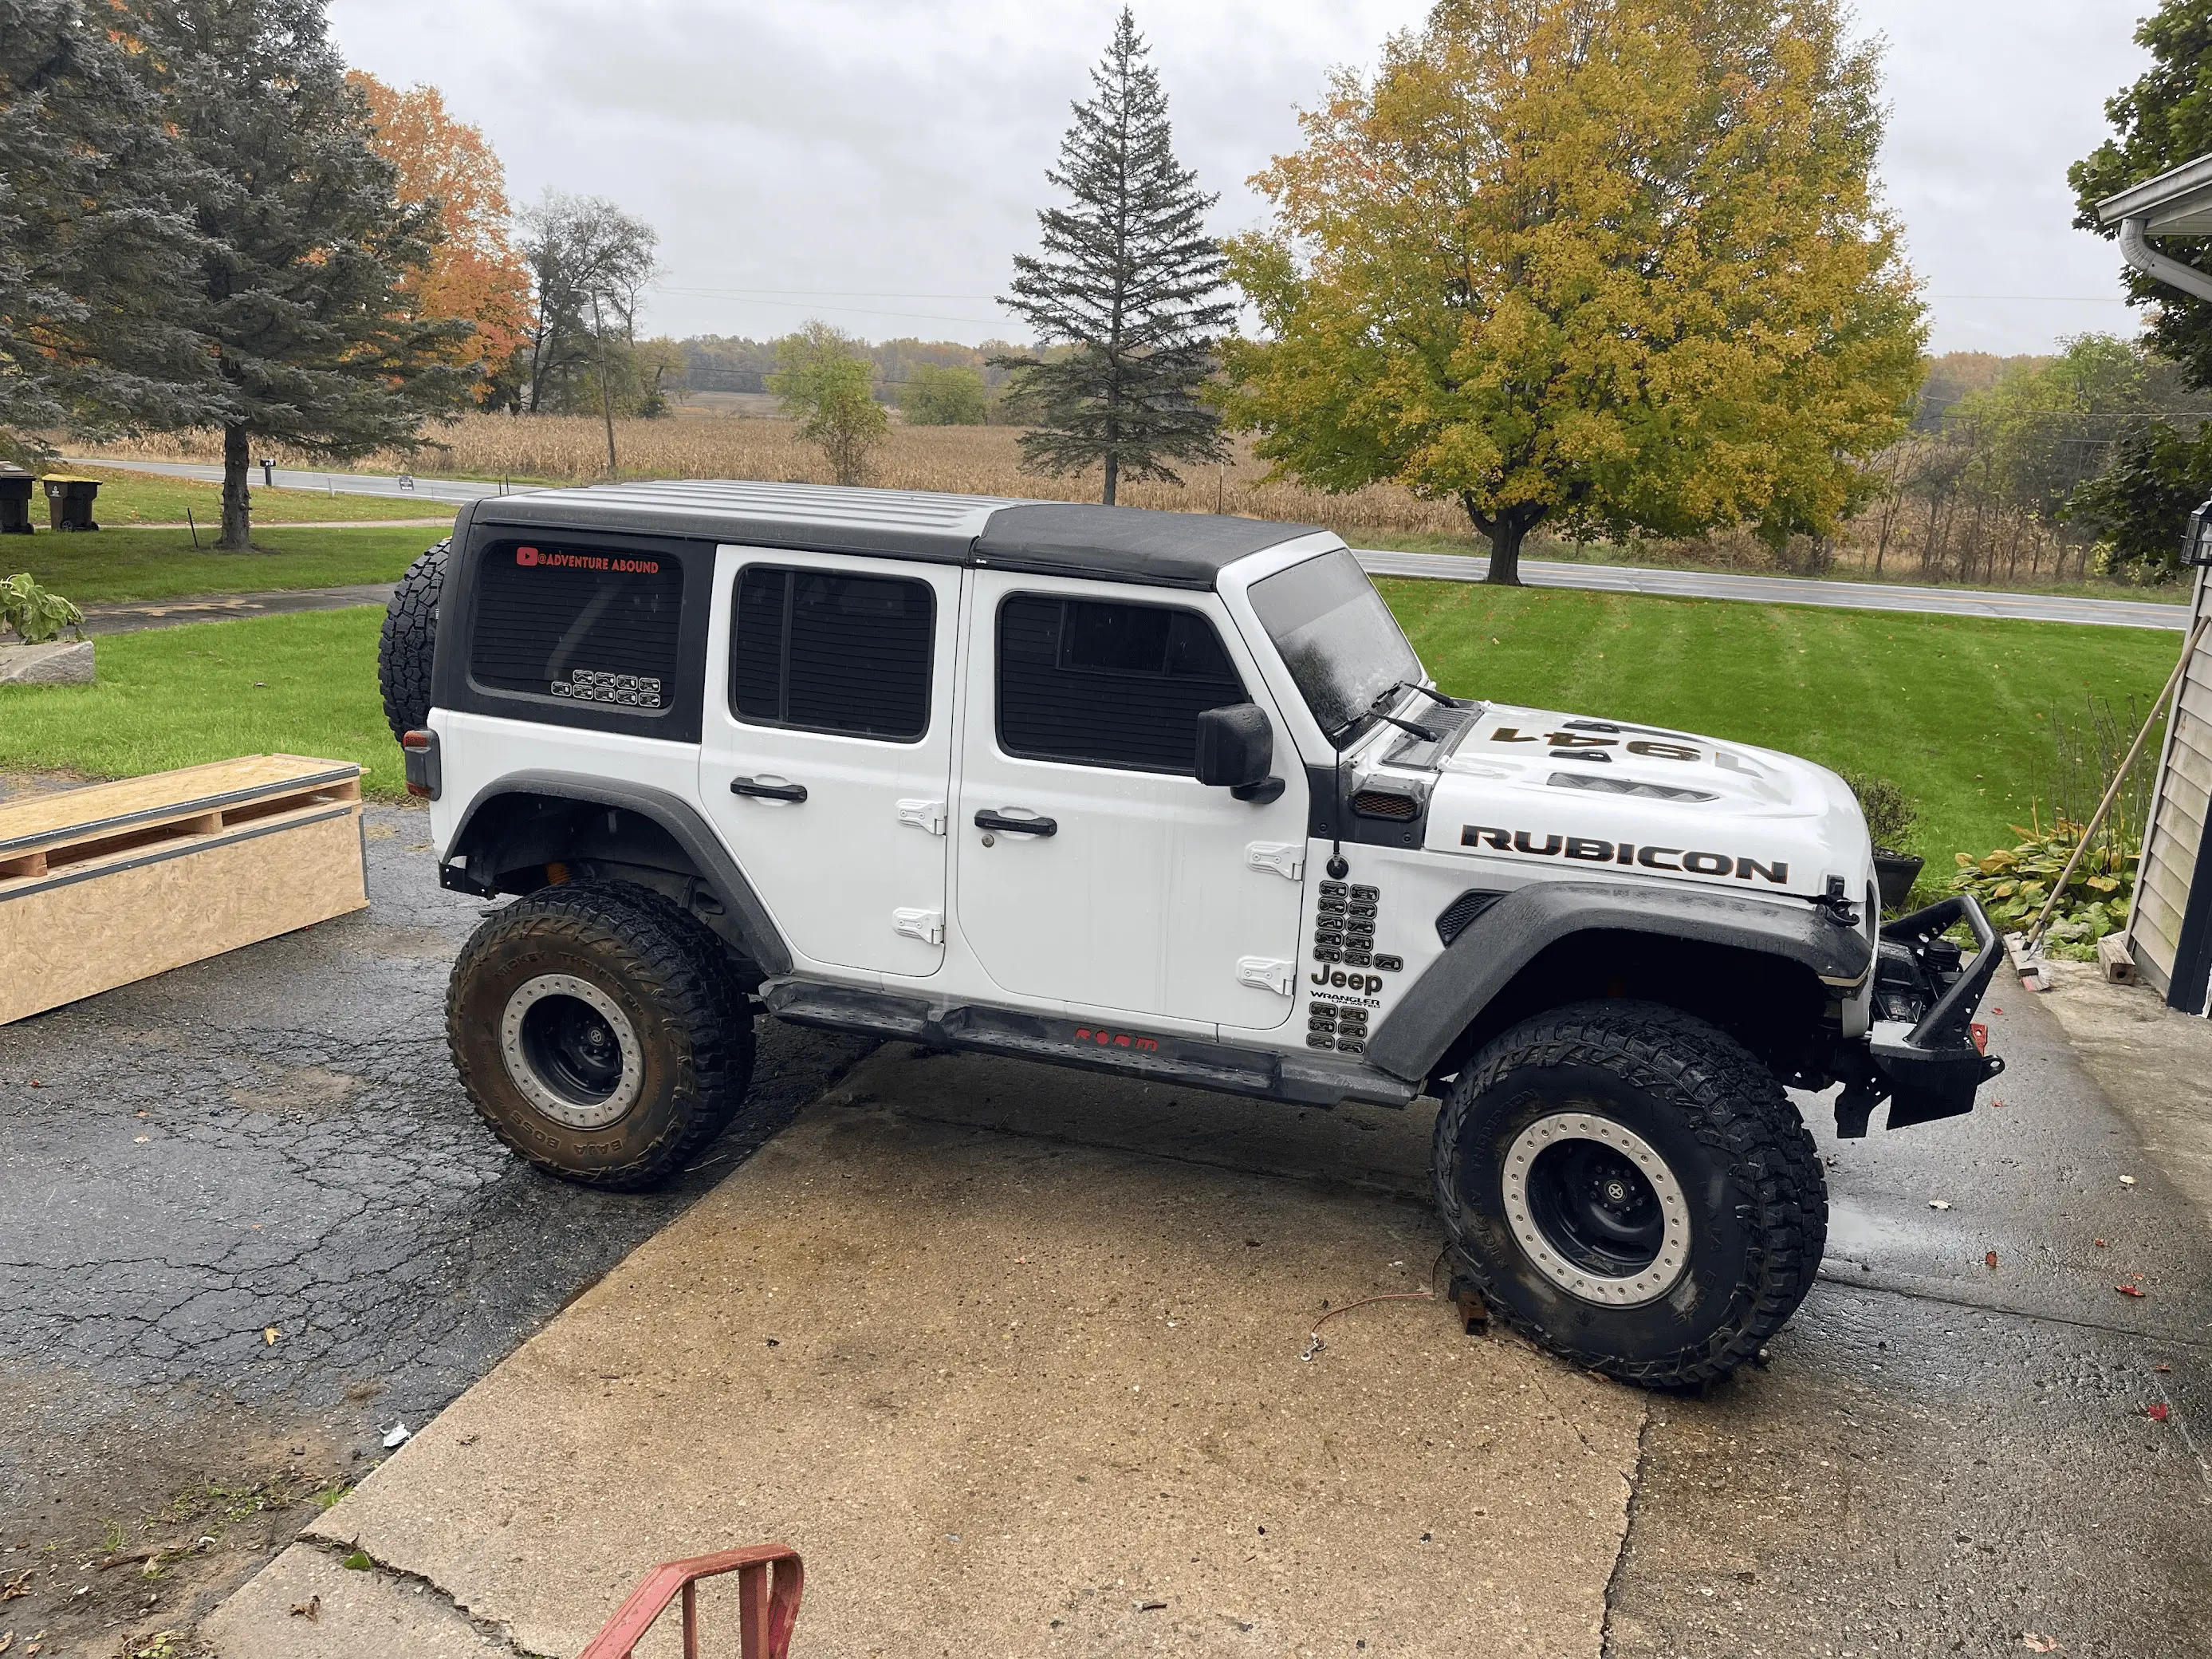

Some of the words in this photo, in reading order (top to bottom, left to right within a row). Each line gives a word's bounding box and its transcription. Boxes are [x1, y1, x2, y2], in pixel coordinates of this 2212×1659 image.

[537, 553, 609, 570] @ADVENTURE
[611, 558, 659, 573] ABOUND
[1460, 824, 1789, 885] RUBICON
[1310, 963, 1383, 996] Jeep
[1310, 990, 1380, 1005] WRANGLER
[1331, 999, 1380, 1009] UNLIMITED
[508, 1109, 561, 1151] BOSS
[572, 1137, 624, 1157] BAJA
